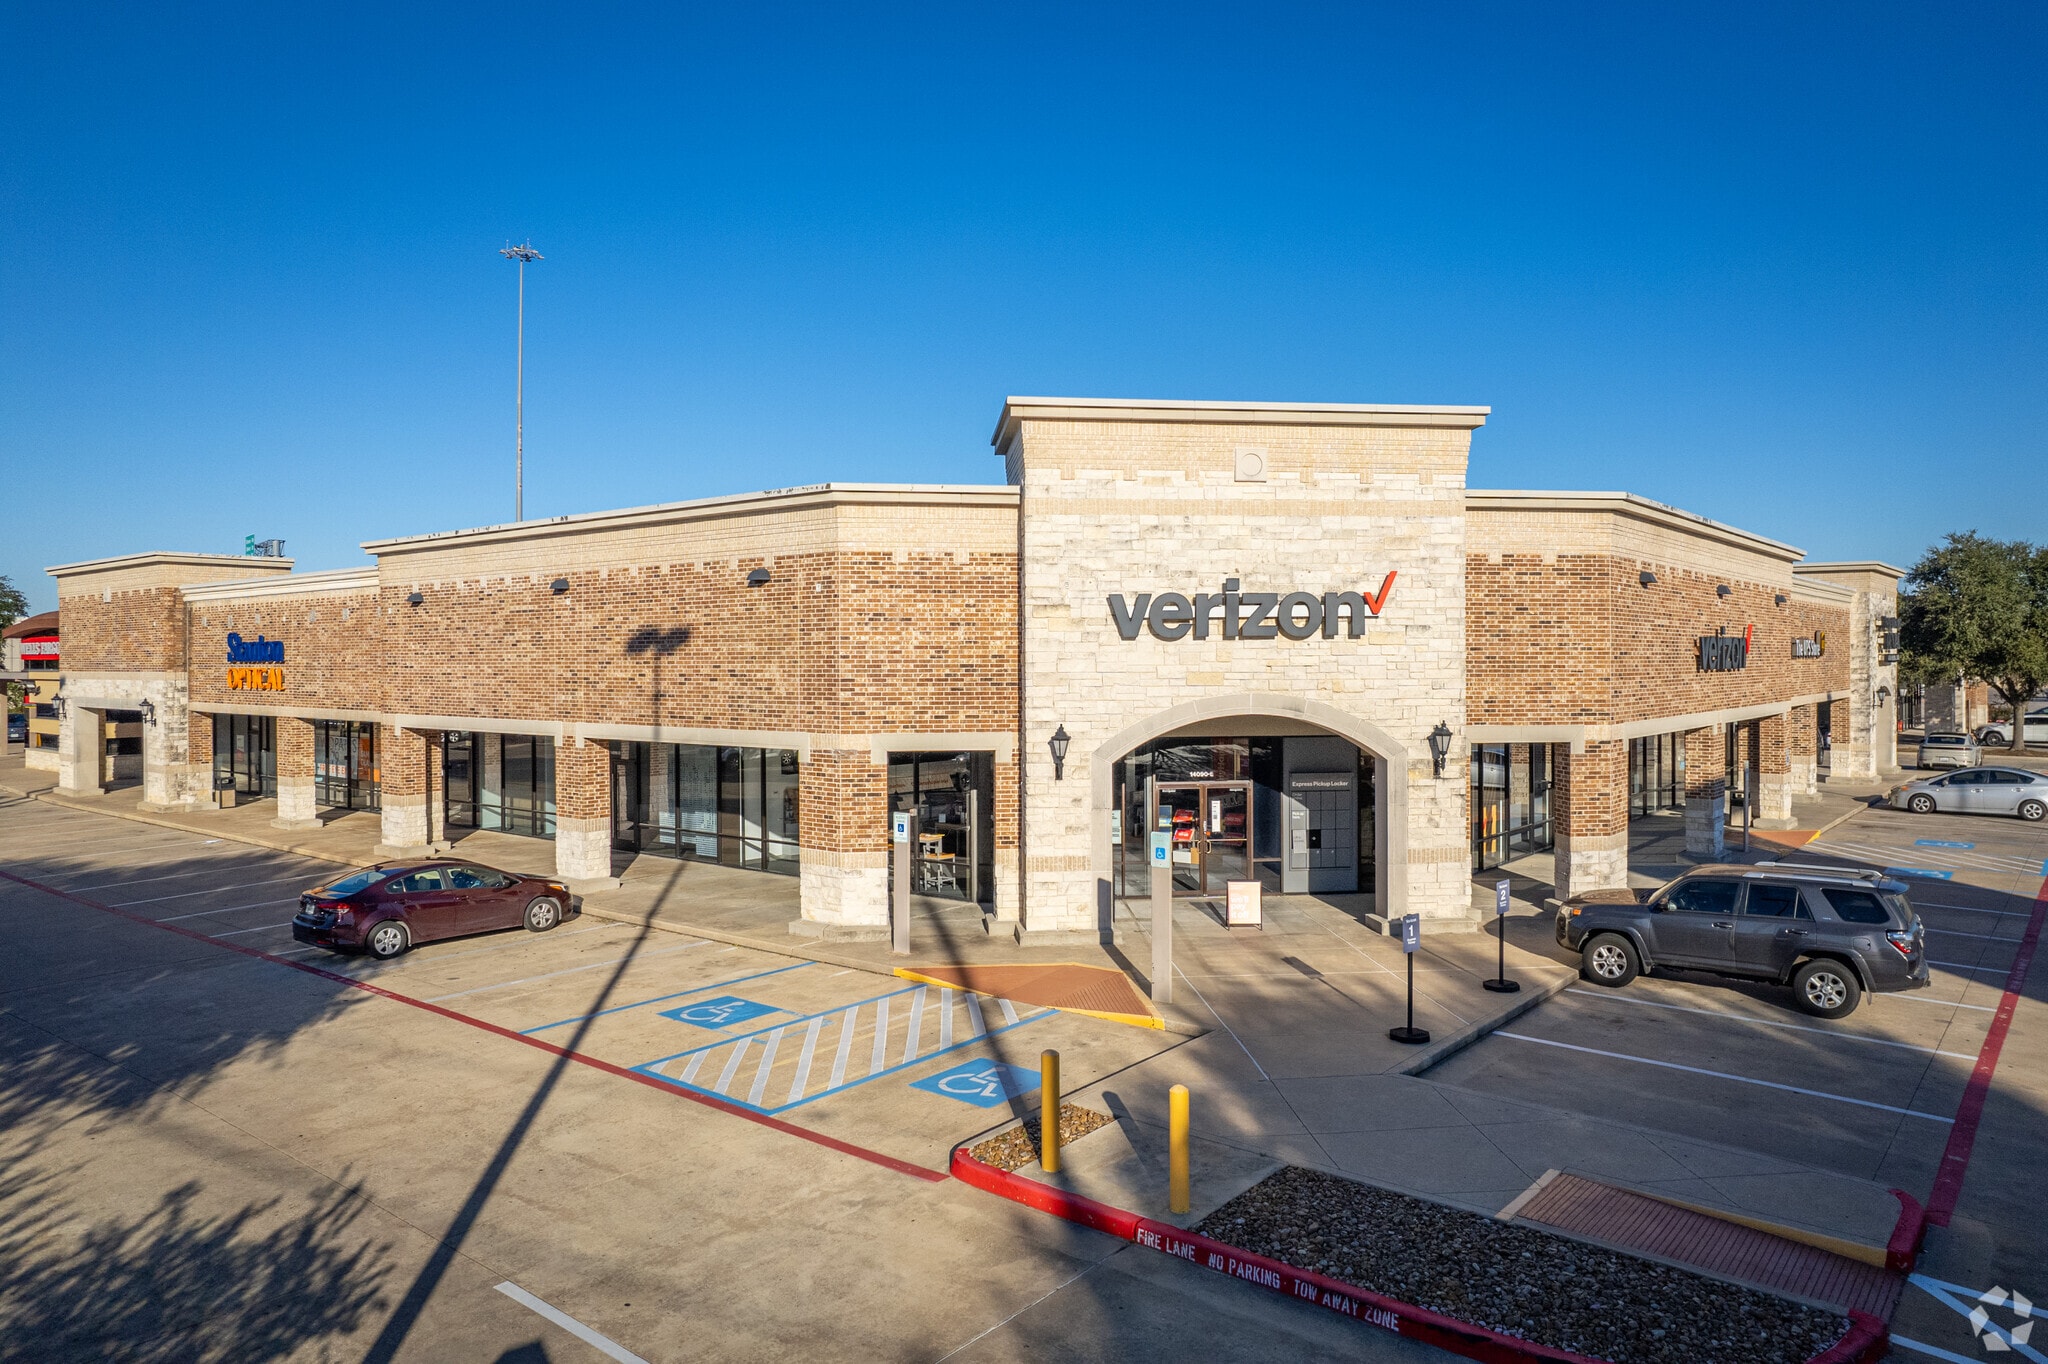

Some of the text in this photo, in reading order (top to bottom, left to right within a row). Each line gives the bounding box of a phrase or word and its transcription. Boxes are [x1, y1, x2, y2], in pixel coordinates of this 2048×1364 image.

[1107, 577, 1366, 641] verizon
[1699, 626, 1746, 671] verizon
[227, 667, 286, 691] OPTICAL
[1500, 890, 1506, 901] 2
[1408, 925, 1414, 937] 1
[1137, 1228, 1400, 1332] FIRE LANE NO PARKING TOW AWAY ZONE
